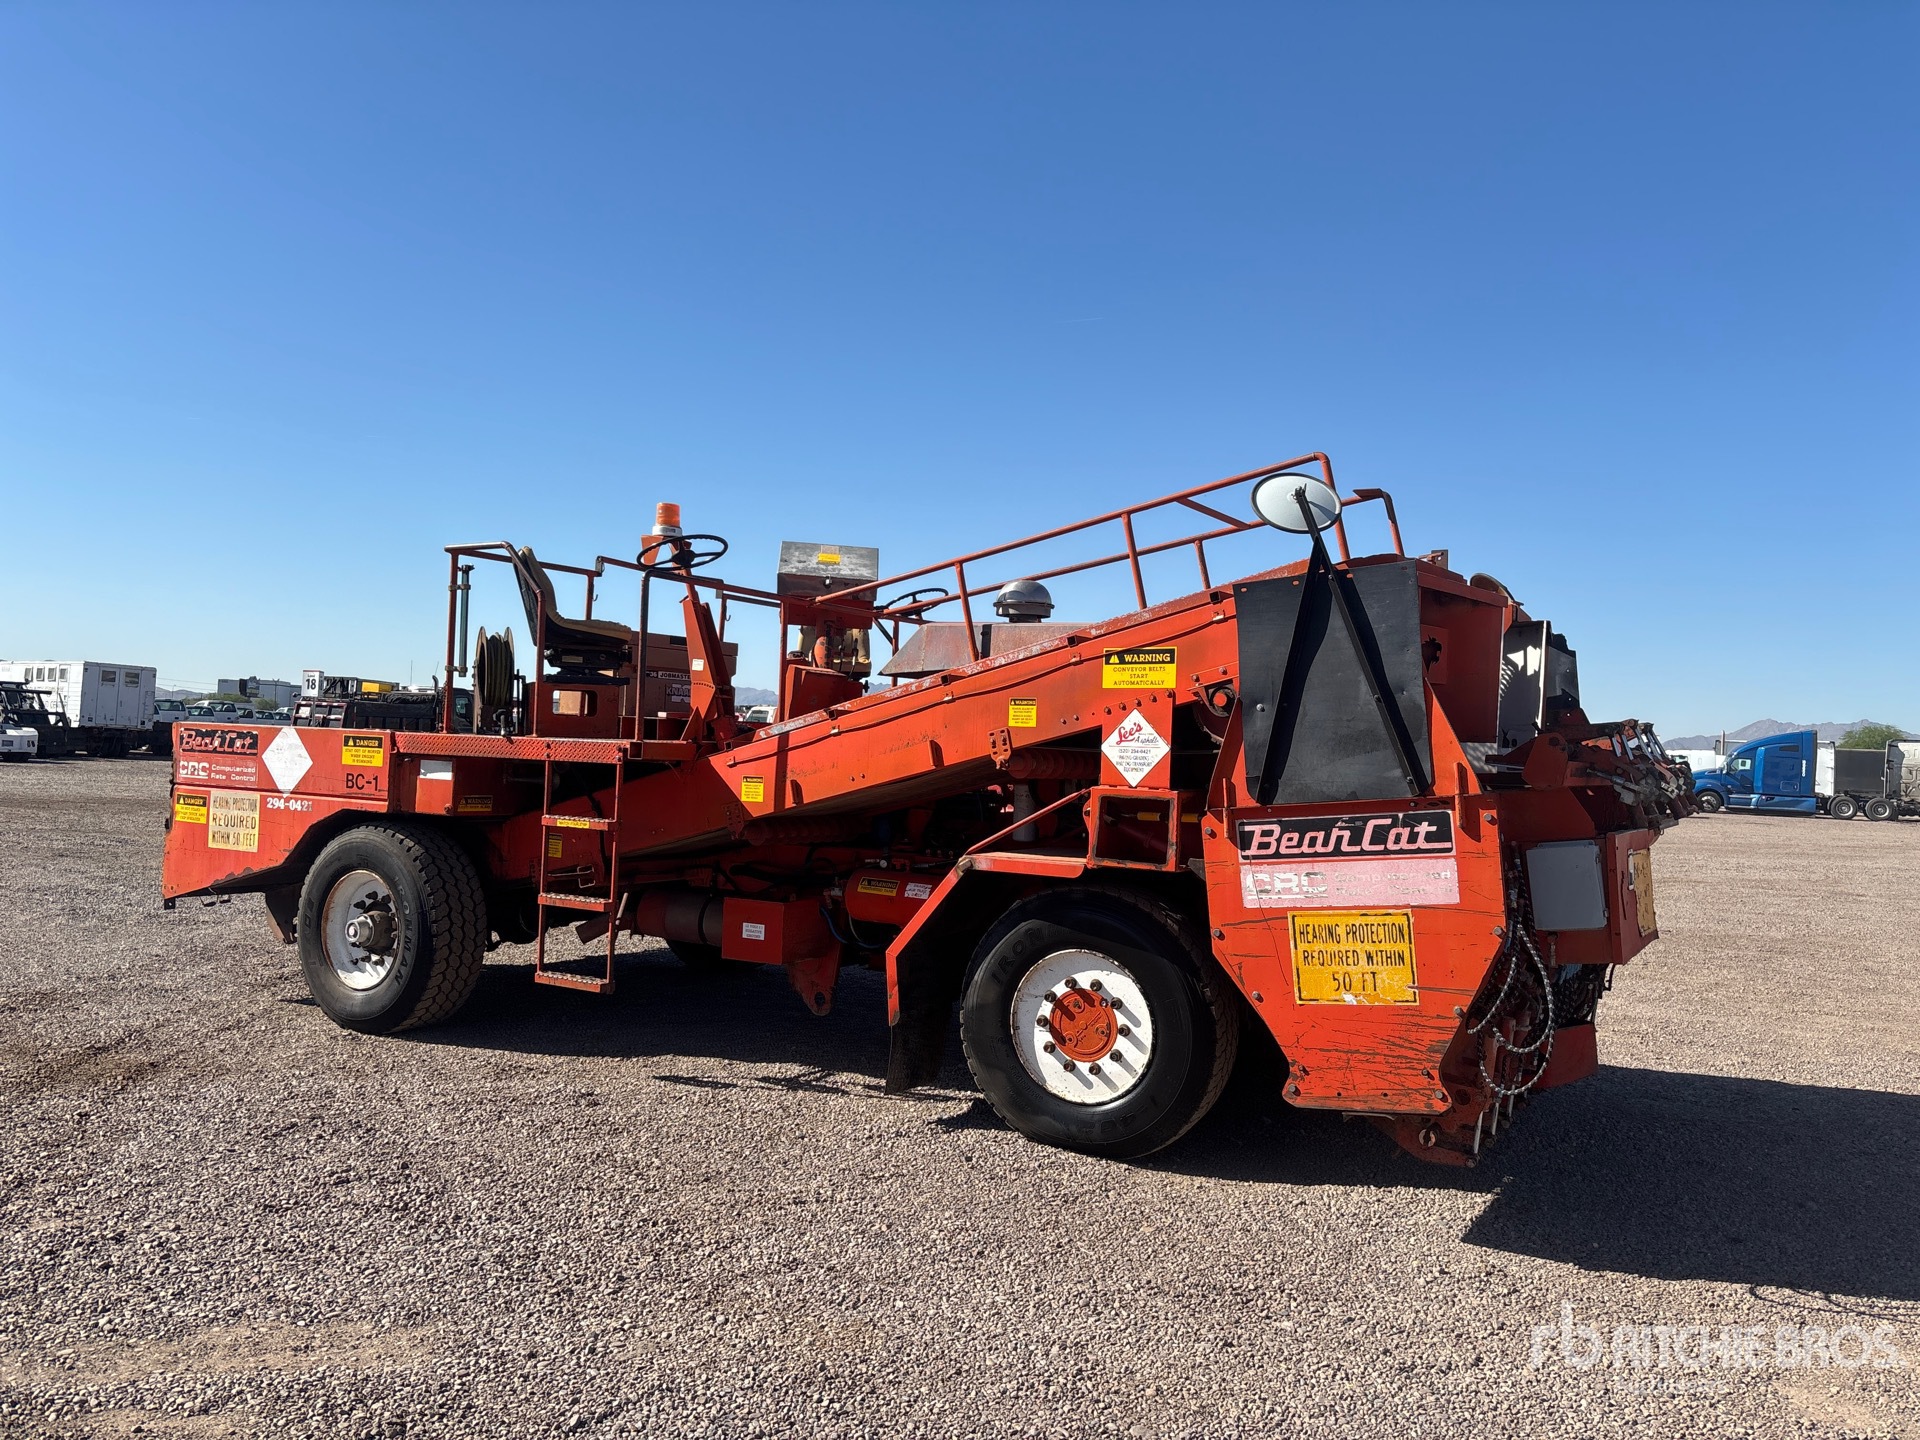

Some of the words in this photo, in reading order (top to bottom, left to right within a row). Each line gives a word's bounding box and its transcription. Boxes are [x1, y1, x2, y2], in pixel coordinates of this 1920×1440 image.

[1124, 653, 1170, 662] WARNING
[306, 679, 316, 690] 18
[666, 686, 689, 696] KNAA
[1116, 722, 1143, 745] Lee's
[356, 739, 379, 747] DANGER
[212, 764, 255, 773] Computerized
[346, 773, 379, 791] BC-1
[184, 797, 203, 805] DANGER
[212, 813, 257, 830] REQUIRED
[212, 830, 231, 845] WITHIN
[233, 832, 240, 846] 50
[242, 832, 256, 847] FEET
[1246, 871, 1328, 895] CRC
[1299, 923, 1341, 944] HEARING
[1345, 922, 1406, 944] PROTECTION
[1303, 950, 1360, 967] REQUIRED
[1365, 950, 1406, 966] WITHIN
[1332, 971, 1352, 992] 50
[1362, 971, 1377, 992] FT
